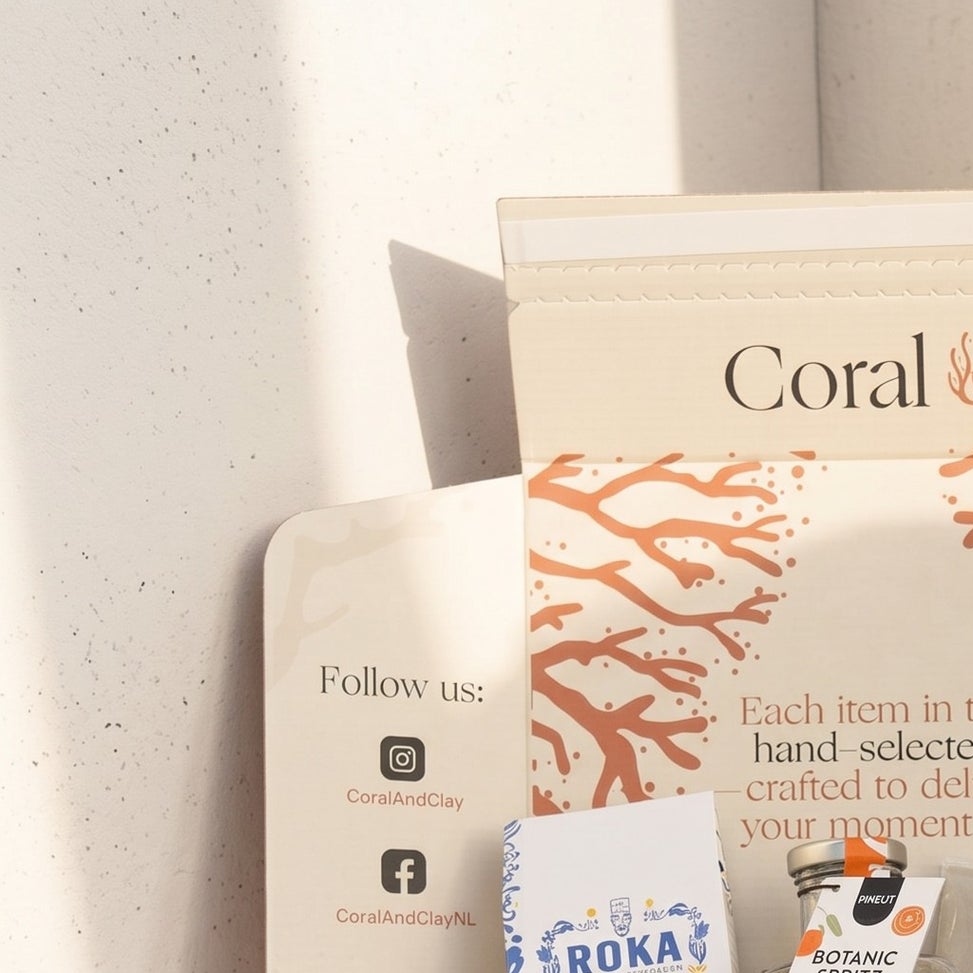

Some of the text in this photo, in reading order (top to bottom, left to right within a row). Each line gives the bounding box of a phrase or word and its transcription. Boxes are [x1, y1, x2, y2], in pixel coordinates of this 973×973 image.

[724, 331, 931, 411] Coral
[319, 665, 485, 703] Follow us:
[740, 692, 824, 726] Each
[837, 695, 910, 724] item
[923, 694, 953, 724] in
[346, 788, 465, 812] CoralAndClay
[875, 775, 908, 800] to
[740, 817, 817, 849] your
[829, 810, 973, 840] moment
[857, 894, 897, 906] PINEUT
[335, 908, 477, 930] CoralAndClayNL
[811, 949, 899, 967] BOTANIC
